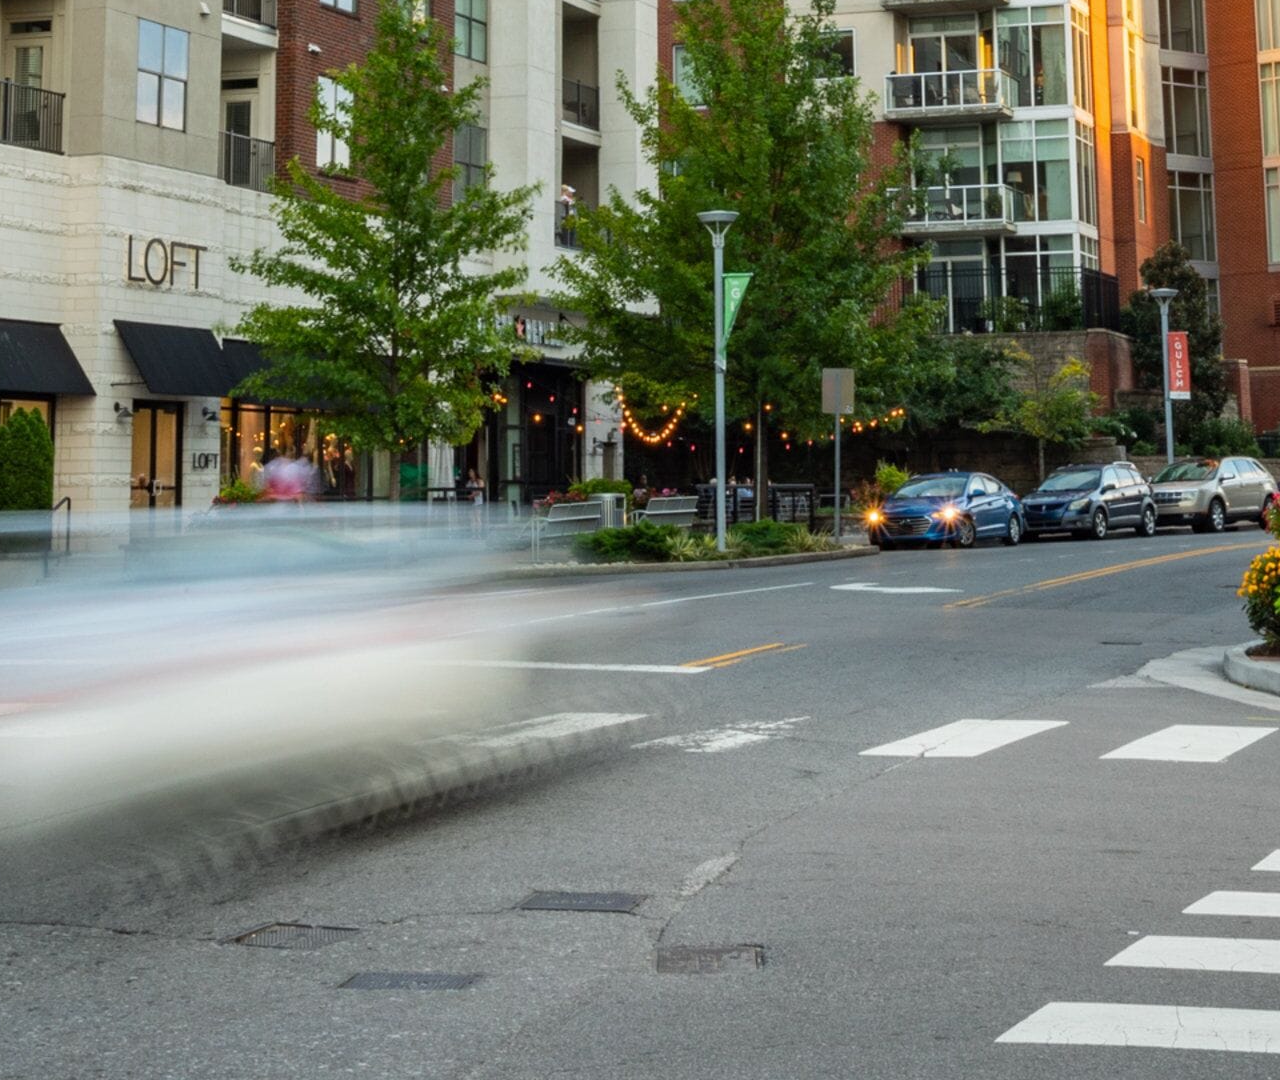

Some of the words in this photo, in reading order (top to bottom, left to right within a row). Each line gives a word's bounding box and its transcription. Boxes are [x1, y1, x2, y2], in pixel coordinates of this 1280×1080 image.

[128, 234, 208, 290] LOFT
[1174, 341, 1184, 387] GULCH
[192, 452, 219, 470] LOFT
